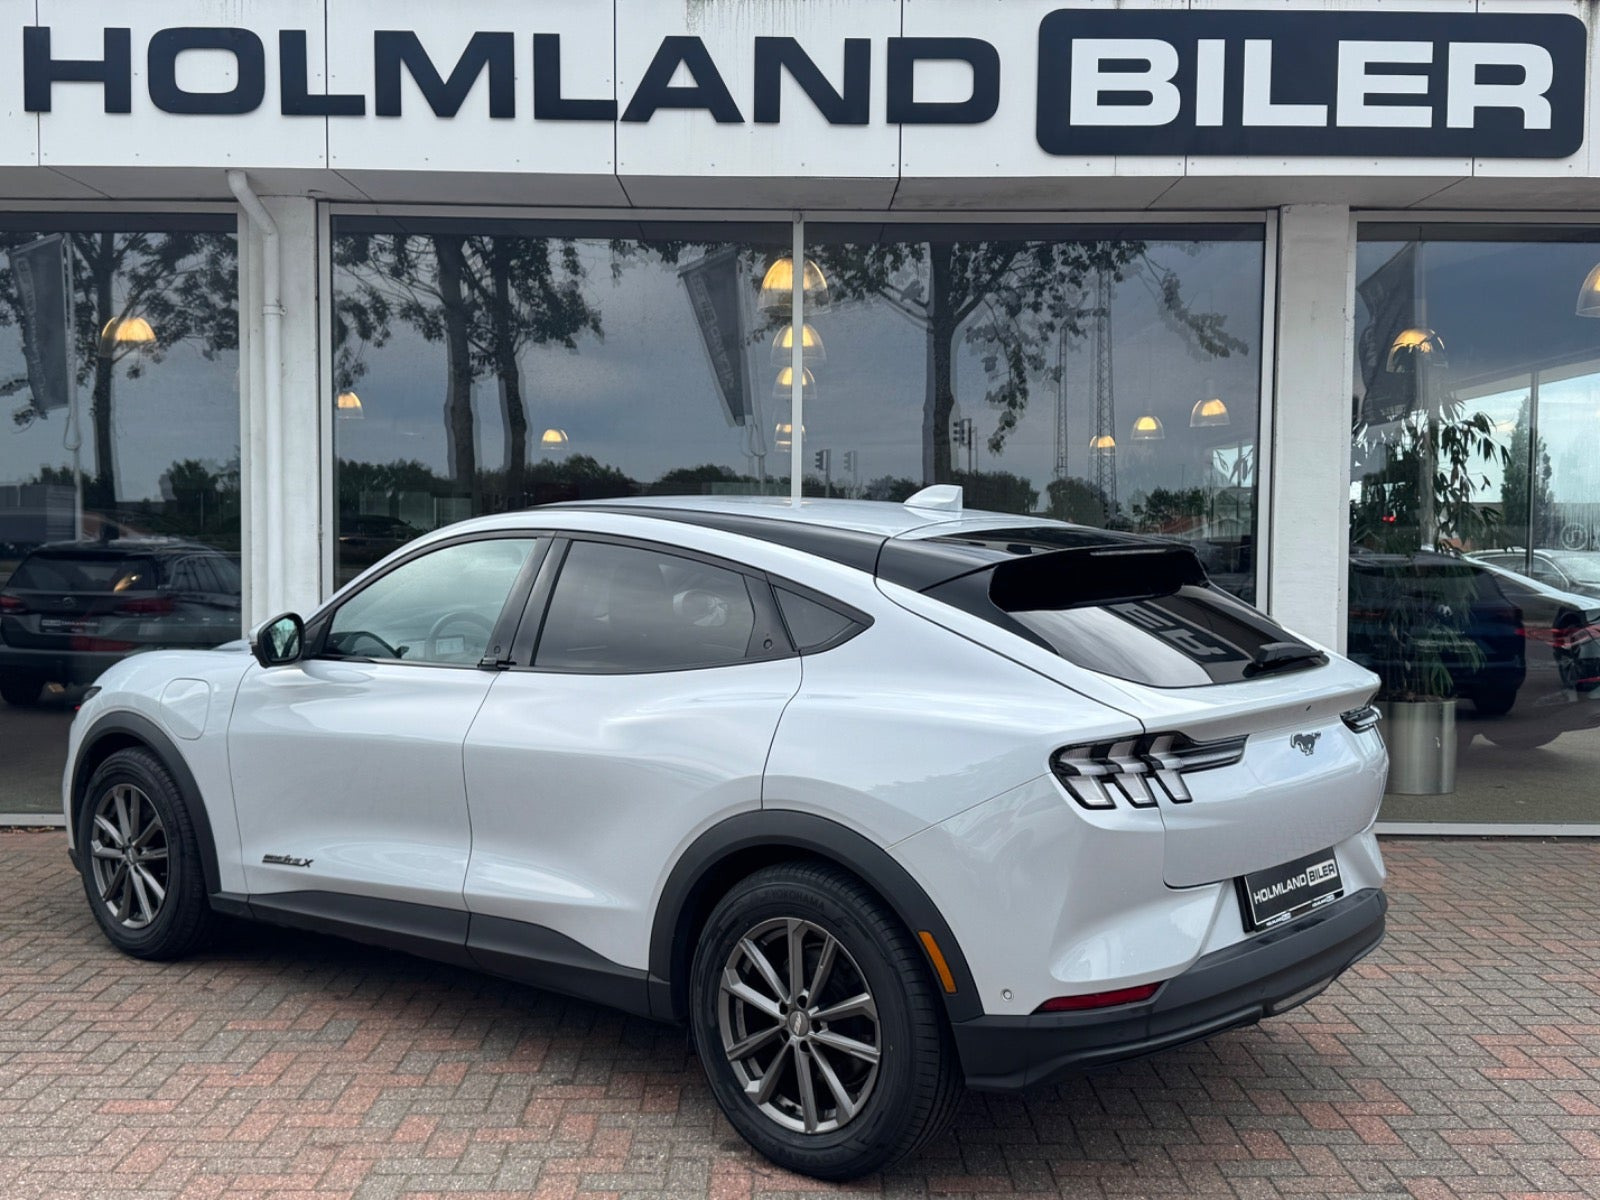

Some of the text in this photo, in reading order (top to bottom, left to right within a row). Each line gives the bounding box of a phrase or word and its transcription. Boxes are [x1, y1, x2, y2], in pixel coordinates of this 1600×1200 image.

[23, 25, 1554, 130] HOLMLAND BILER
[1253, 874, 1307, 905] HOLMLAND
[1308, 863, 1336, 883] BILER
